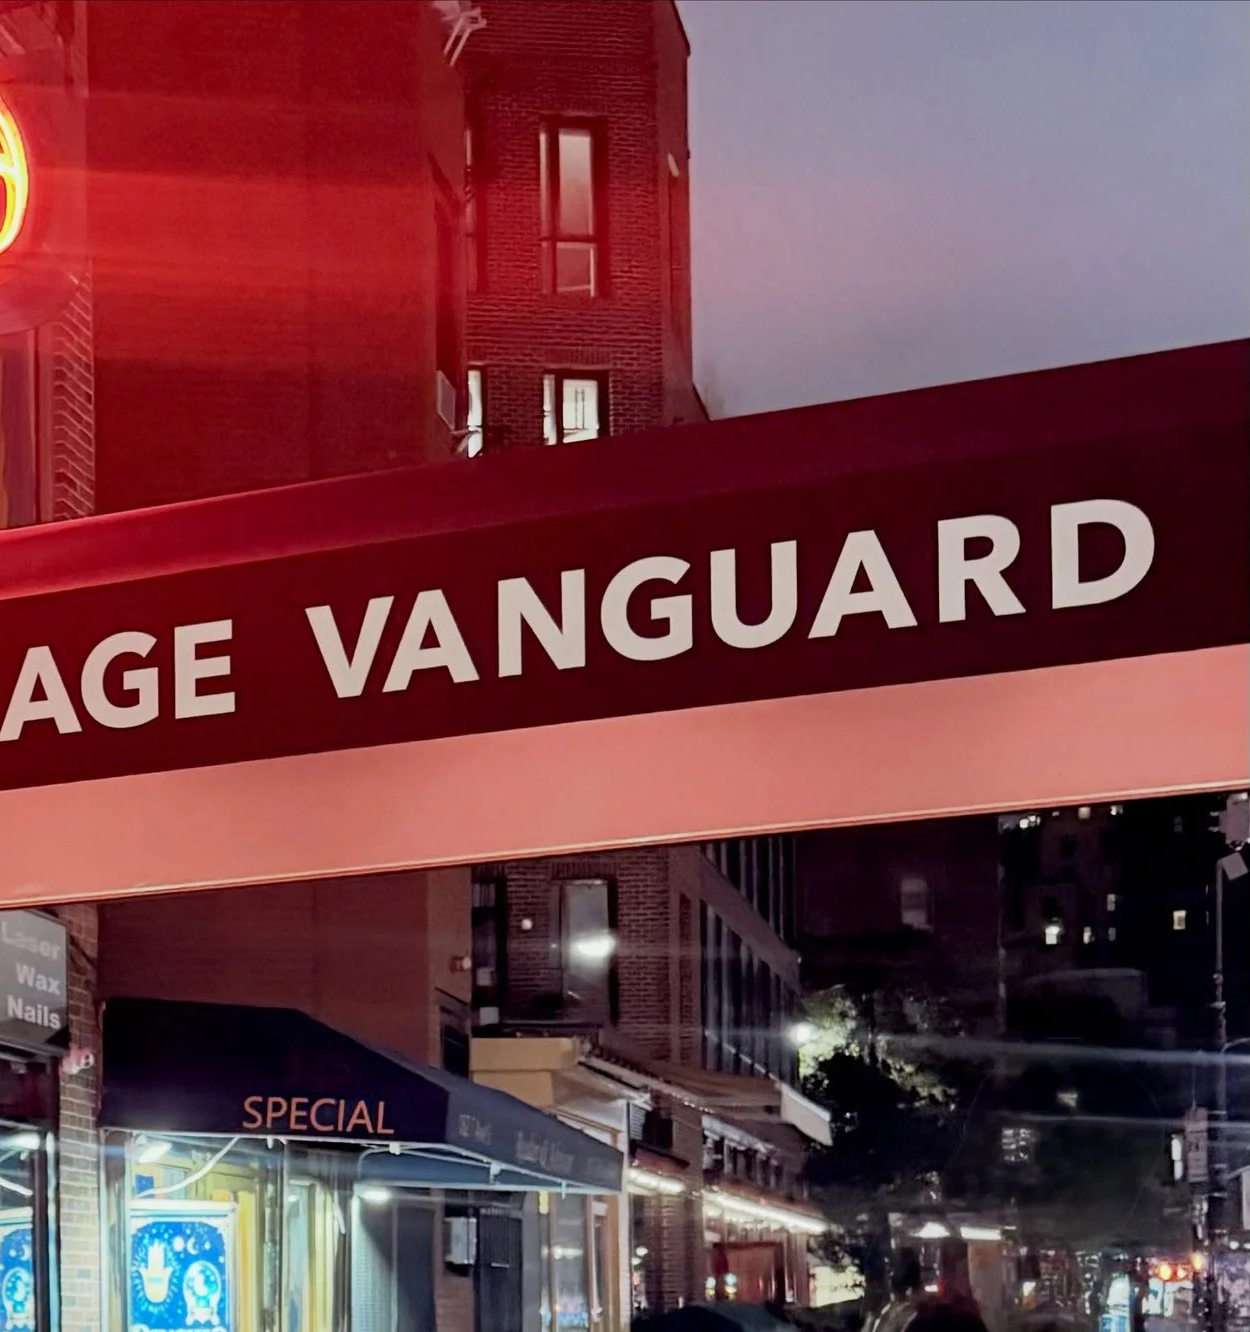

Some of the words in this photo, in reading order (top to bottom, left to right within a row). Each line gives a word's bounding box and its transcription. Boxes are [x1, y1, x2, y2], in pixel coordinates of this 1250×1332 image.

[304, 499, 1155, 699] VANGUARD
[1, 920, 61, 960] Laser
[15, 962, 60, 996] Wax
[7, 994, 61, 1030] Nails
[242, 1095, 395, 1134] SPECIAL
